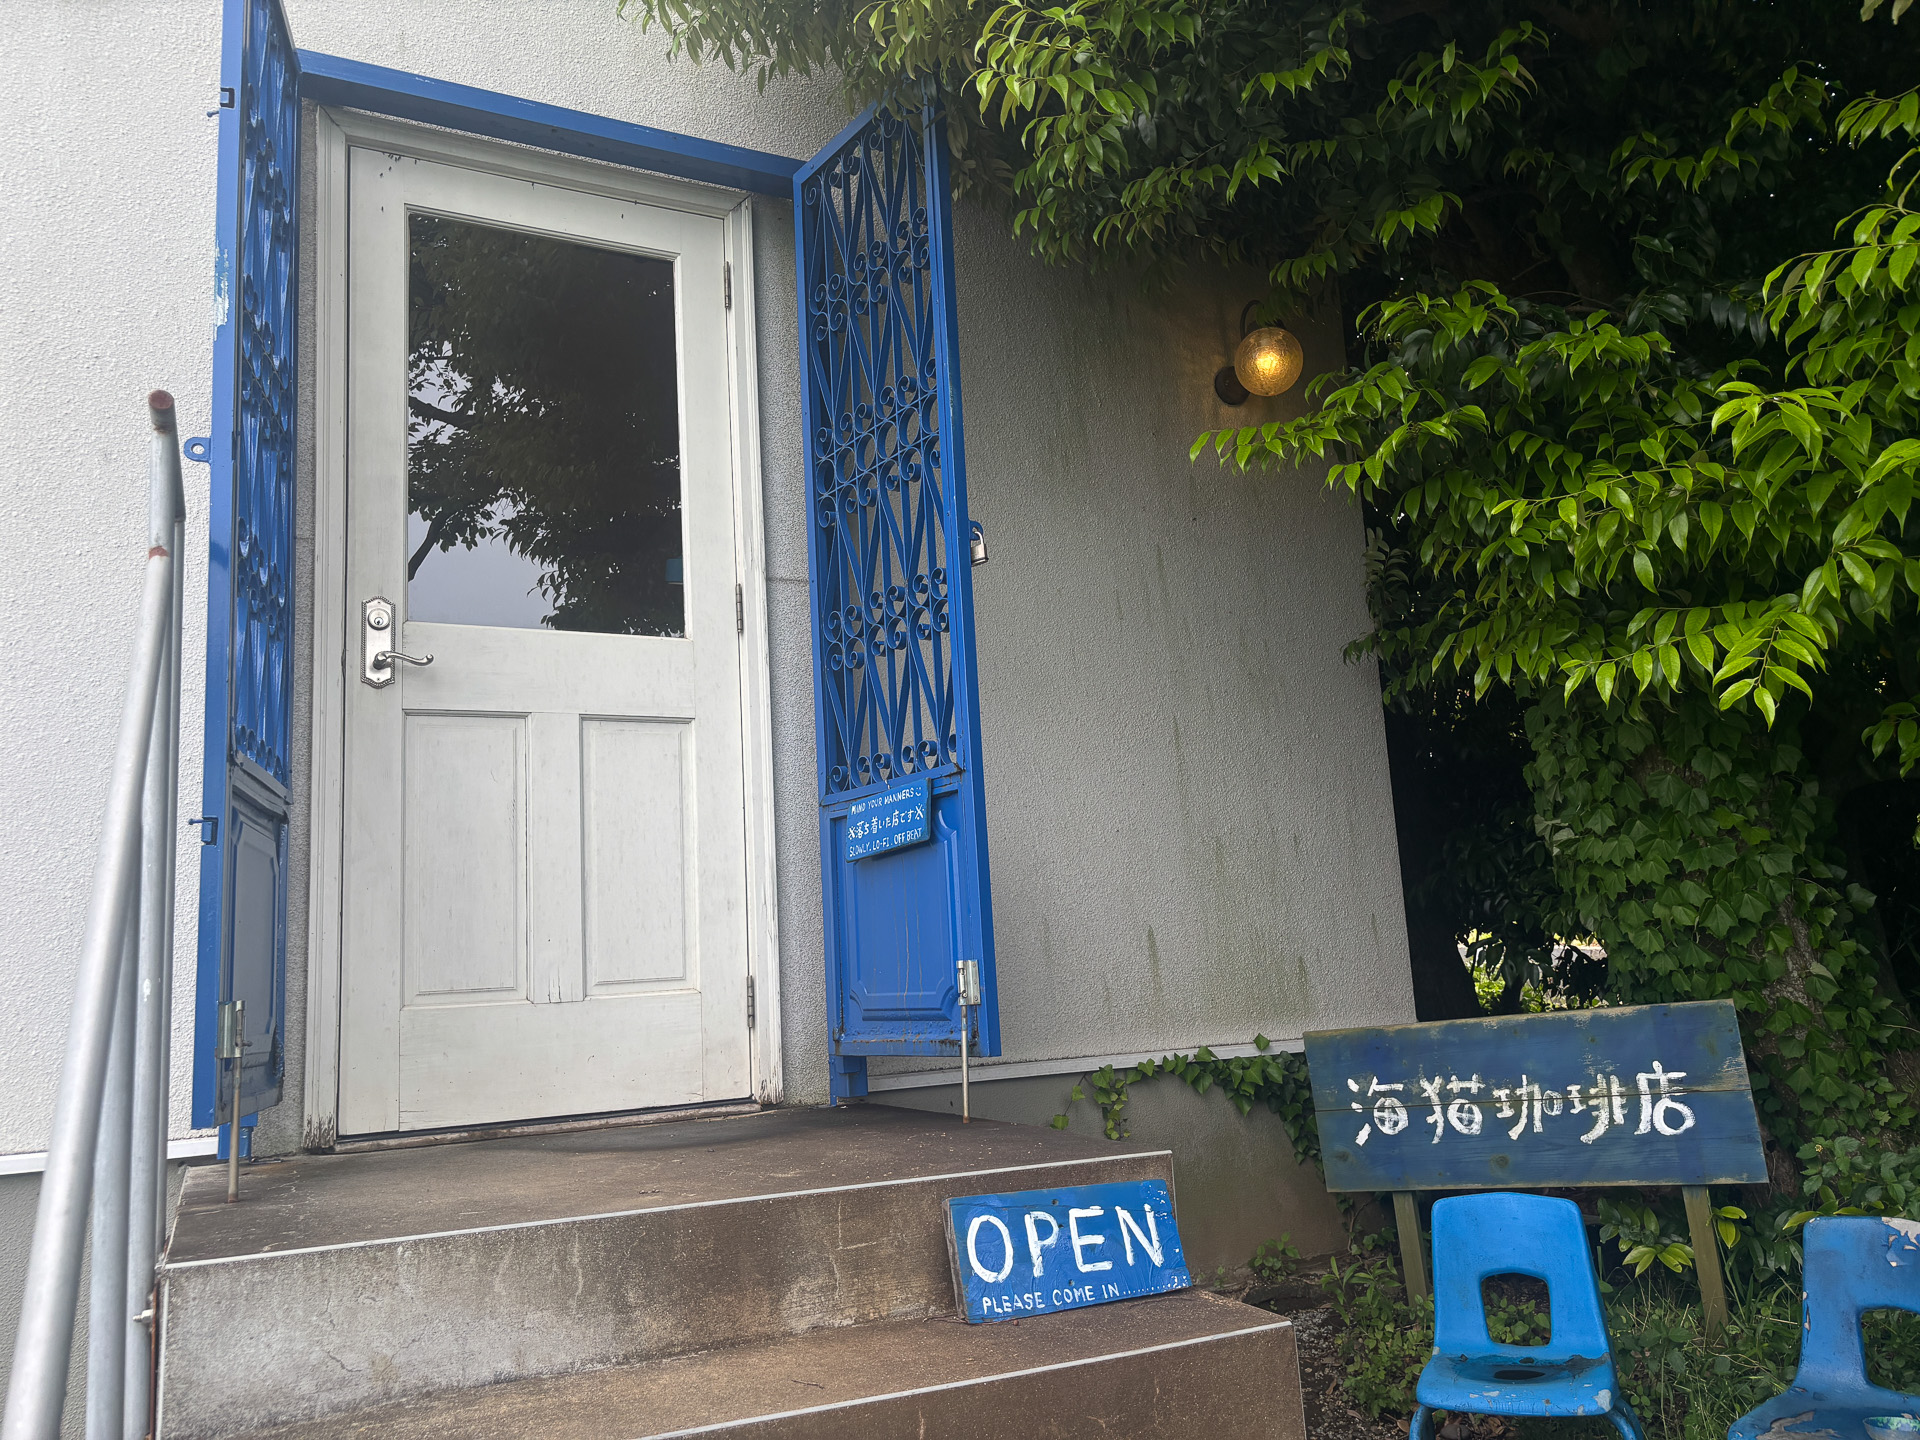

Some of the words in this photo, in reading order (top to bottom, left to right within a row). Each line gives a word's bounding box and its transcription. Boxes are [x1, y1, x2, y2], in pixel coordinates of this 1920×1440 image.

[868, 797, 883, 809] YOUR
[884, 787, 914, 805] MANNERS
[894, 832, 905, 844] OFF
[906, 828, 922, 841] BEAT
[1346, 1060, 1696, 1147] 海猫珈琲店
[966, 1203, 1165, 1283] OPEN
[982, 1291, 1046, 1315] PLEASE
[1052, 1285, 1096, 1306] COME
